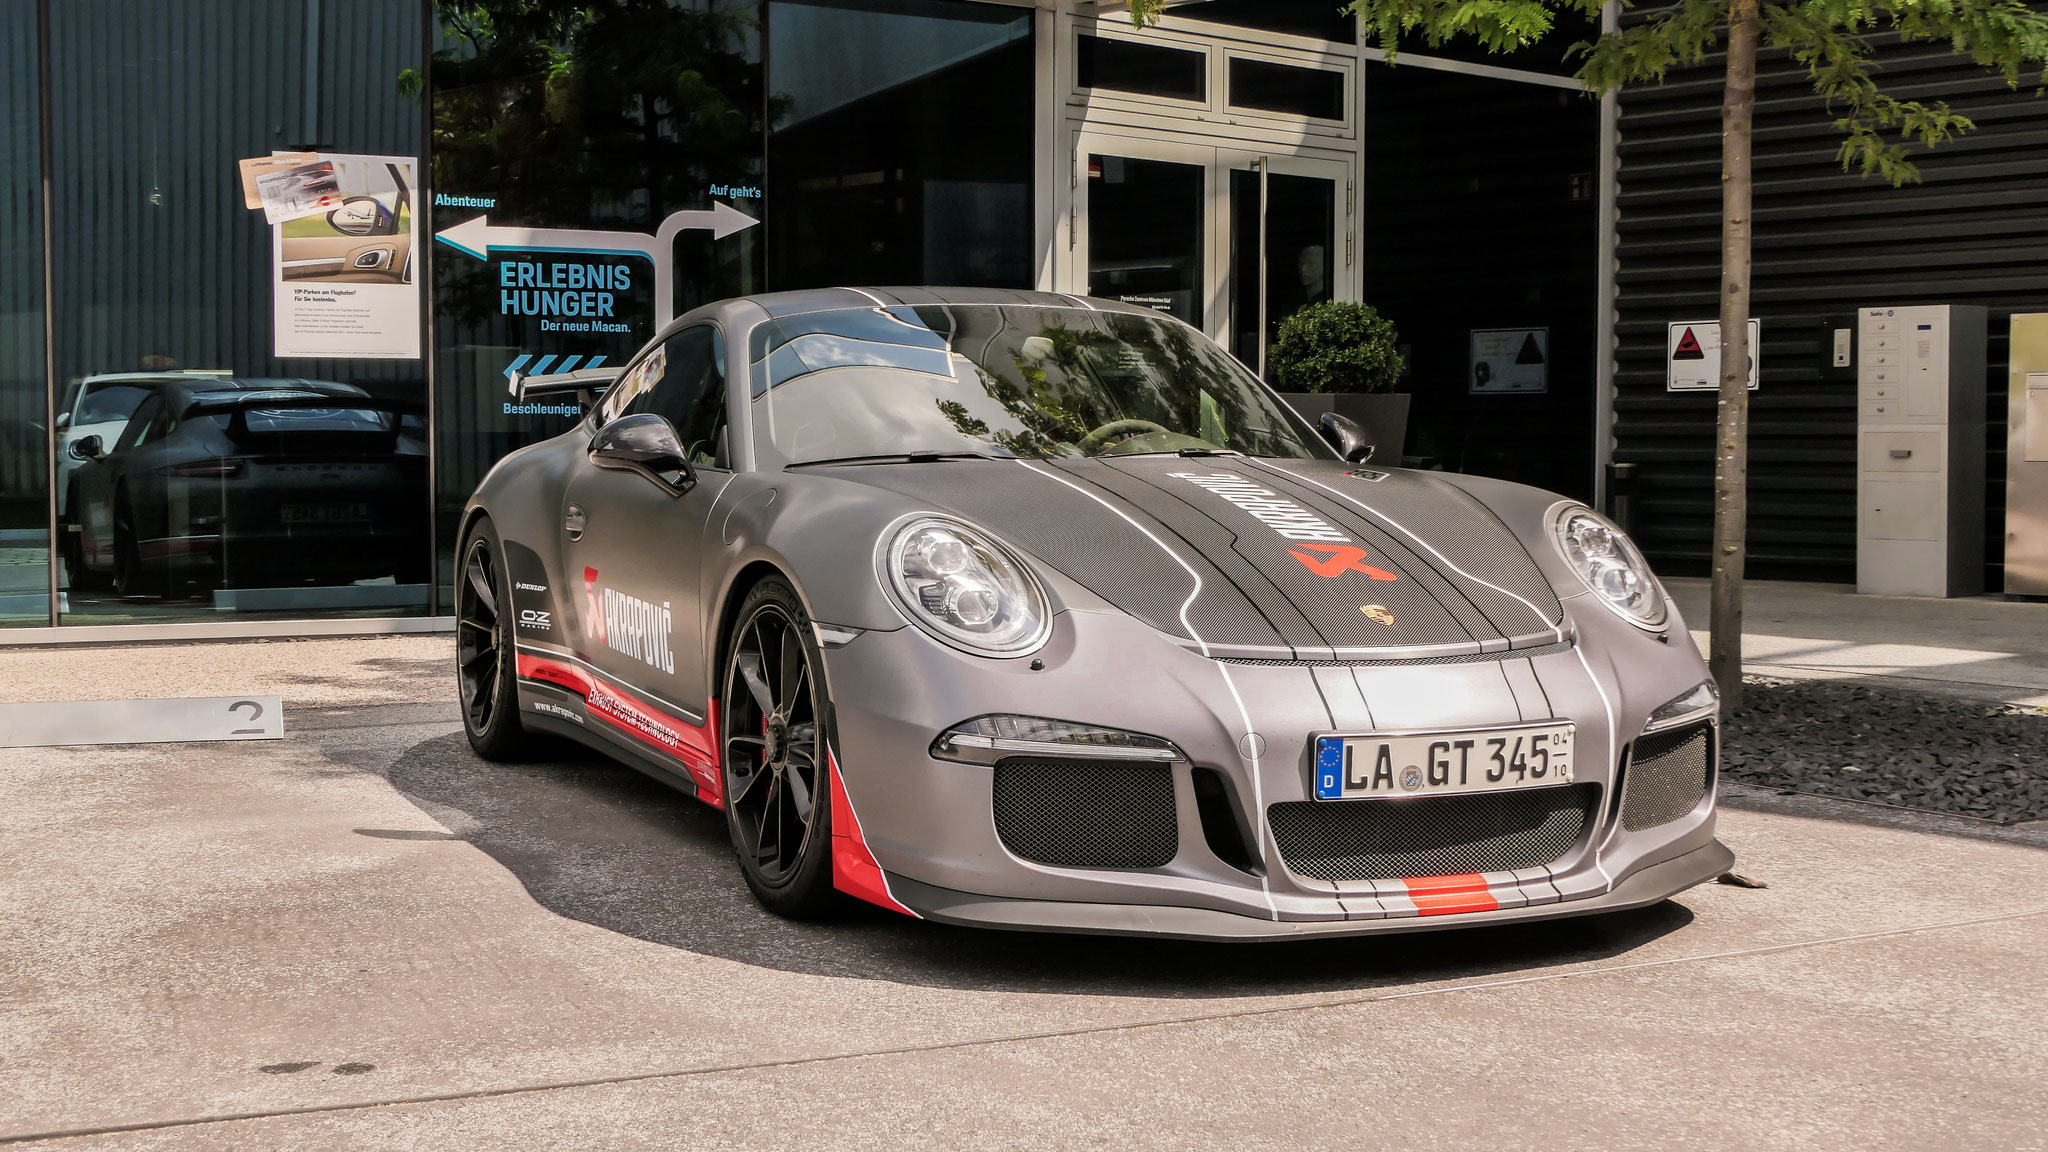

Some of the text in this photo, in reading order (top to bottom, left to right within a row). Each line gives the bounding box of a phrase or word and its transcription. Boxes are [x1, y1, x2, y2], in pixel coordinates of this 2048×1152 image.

[709, 183, 761, 199] Auf geht's
[434, 193, 496, 208] Abenteuer
[500, 261, 631, 290] ERLEBNIS
[501, 289, 614, 317] HUNGER
[541, 319, 631, 333] Der neue Macan.
[521, 583, 547, 592] DUNLOP
[228, 700, 265, 735] 2
[588, 687, 681, 748] EXHAUST SYSTEM TECHNOLOGY
[1553, 732, 1568, 746] 04
[1323, 734, 1549, 790] D LA GT 345
[1554, 764, 1567, 778] 10
